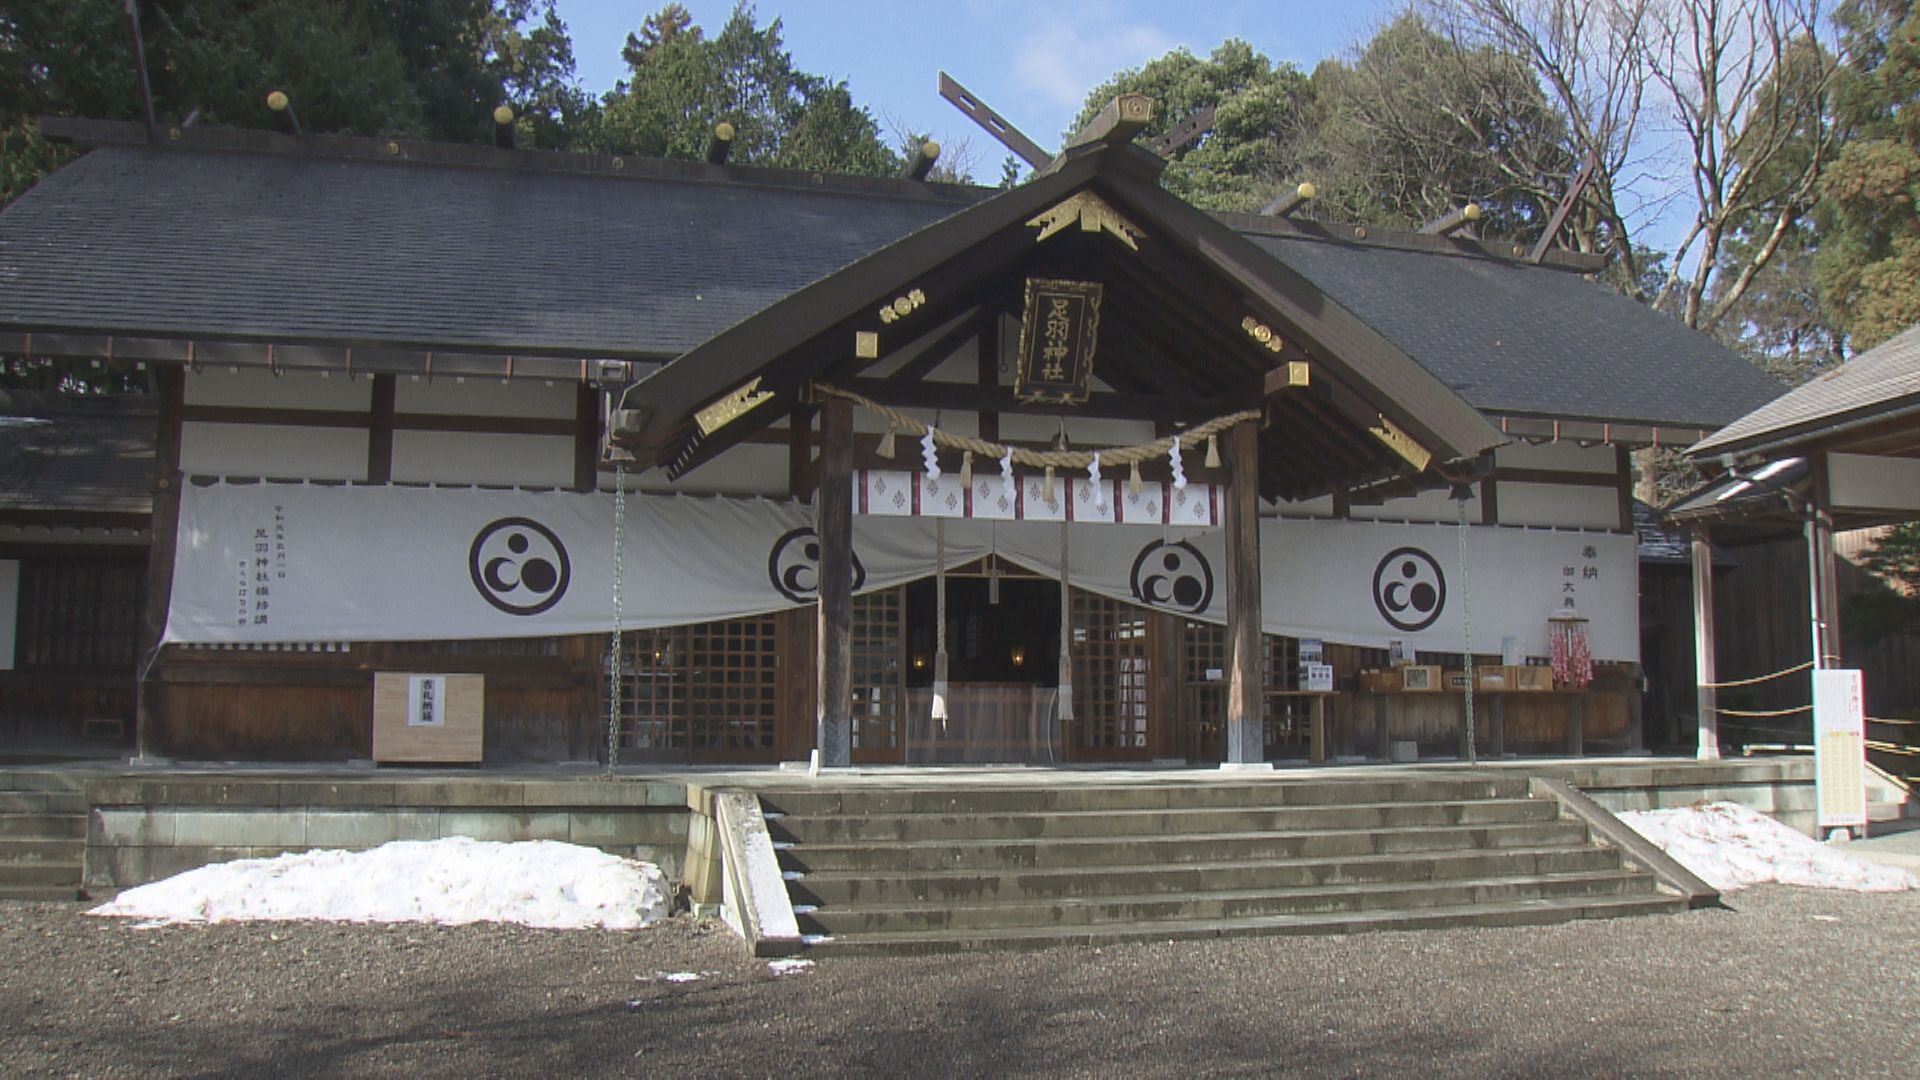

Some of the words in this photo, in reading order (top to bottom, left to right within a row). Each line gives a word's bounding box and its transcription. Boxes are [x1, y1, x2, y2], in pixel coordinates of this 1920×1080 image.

[1042, 299, 1069, 380] 足羽神社
[1582, 545, 1598, 579] 奉納
